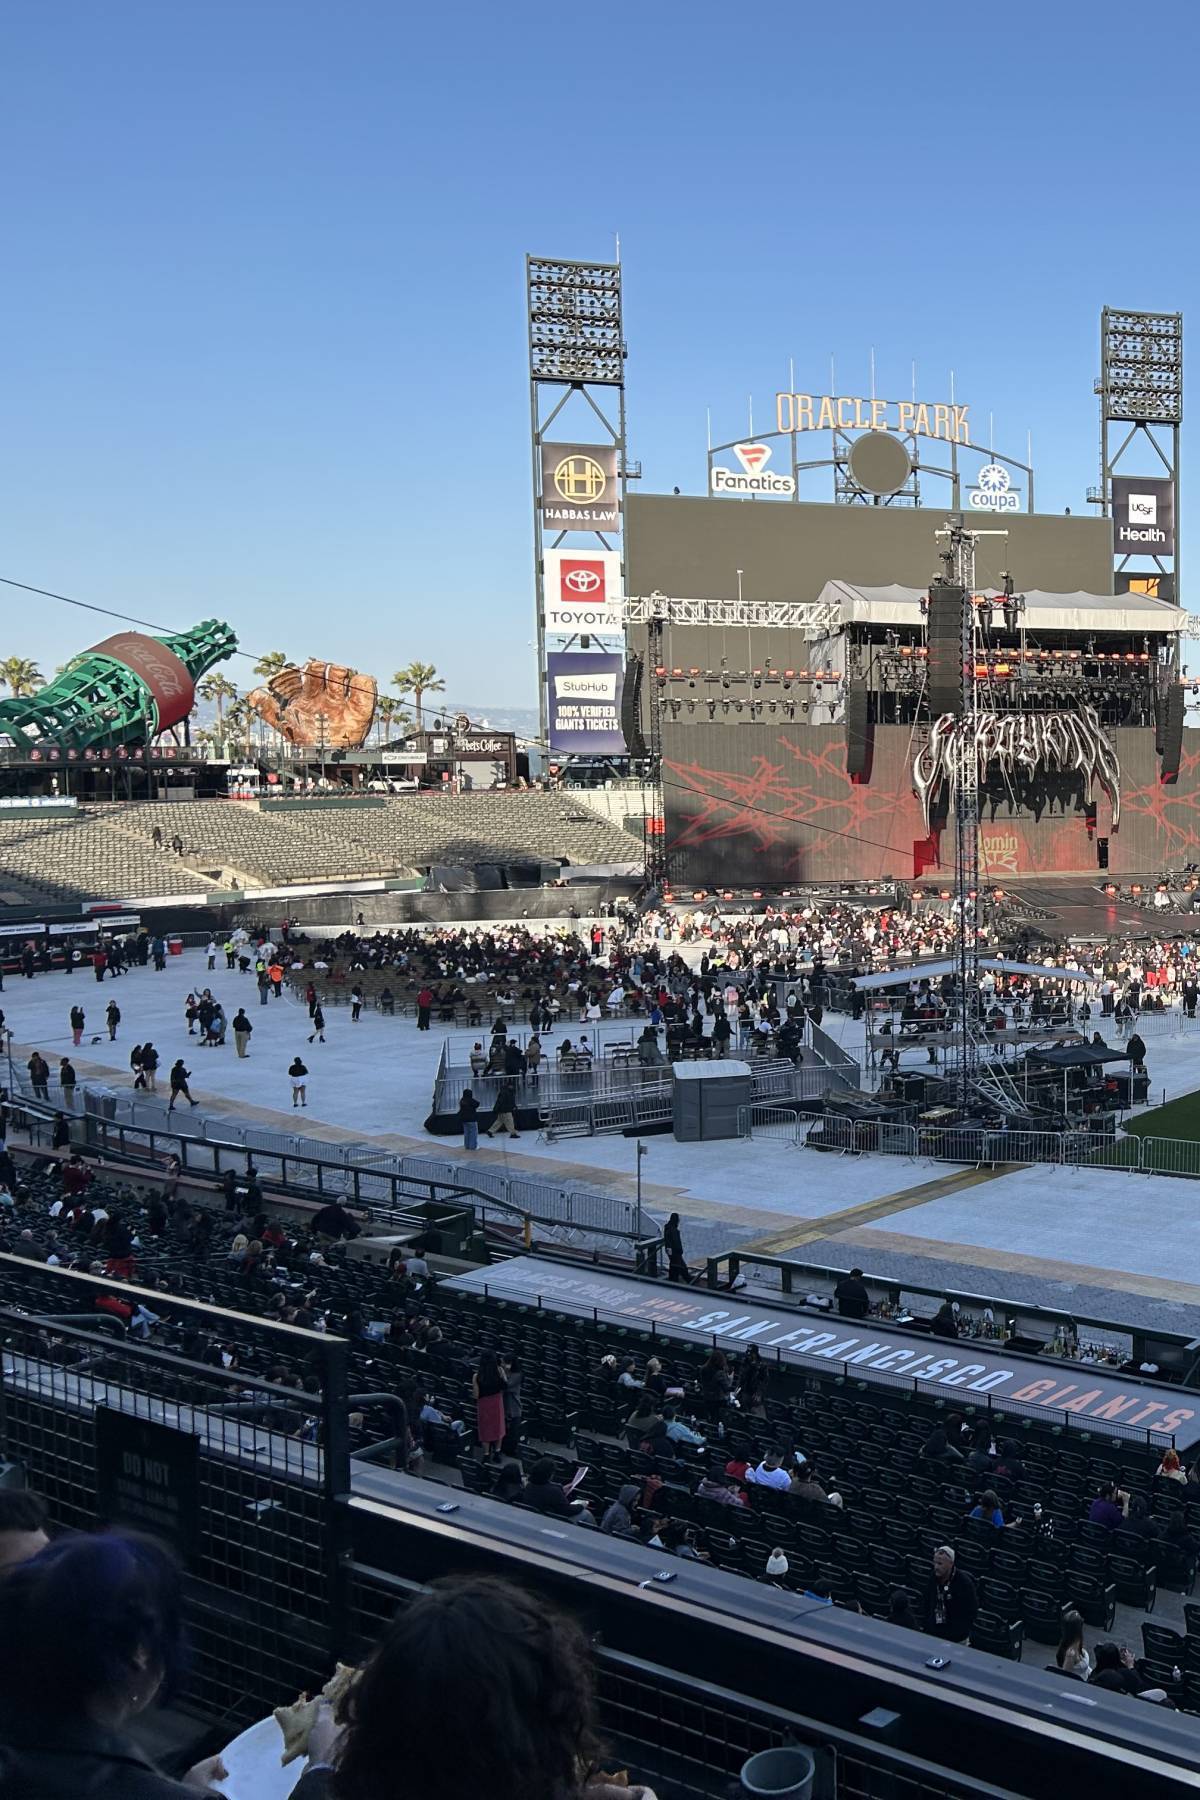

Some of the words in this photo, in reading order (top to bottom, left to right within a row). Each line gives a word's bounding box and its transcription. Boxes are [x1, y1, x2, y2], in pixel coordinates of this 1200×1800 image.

[776, 393, 887, 433] ORACLE
[898, 401, 971, 446] PARK
[715, 471, 792, 492] Fanatics
[971, 492, 1017, 508] coupa
[546, 508, 590, 520] HABBAS
[592, 510, 616, 521] LAW
[1119, 526, 1166, 542] Health
[563, 681, 608, 692] StubHub
[557, 705, 579, 718] 100%
[580, 705, 616, 718] VERIFIED
[555, 718, 585, 731] GIANTS
[585, 718, 619, 731] TICKETS
[480, 738, 502, 753] Coffee
[640, 1297, 704, 1315] HOME
[683, 1311, 780, 1345] SAN
[780, 1327, 1014, 1391] FRANCISCO
[1011, 1379, 1196, 1433] GIANTS
[123, 1451, 142, 1478] DO
[143, 1457, 170, 1488] NOT
